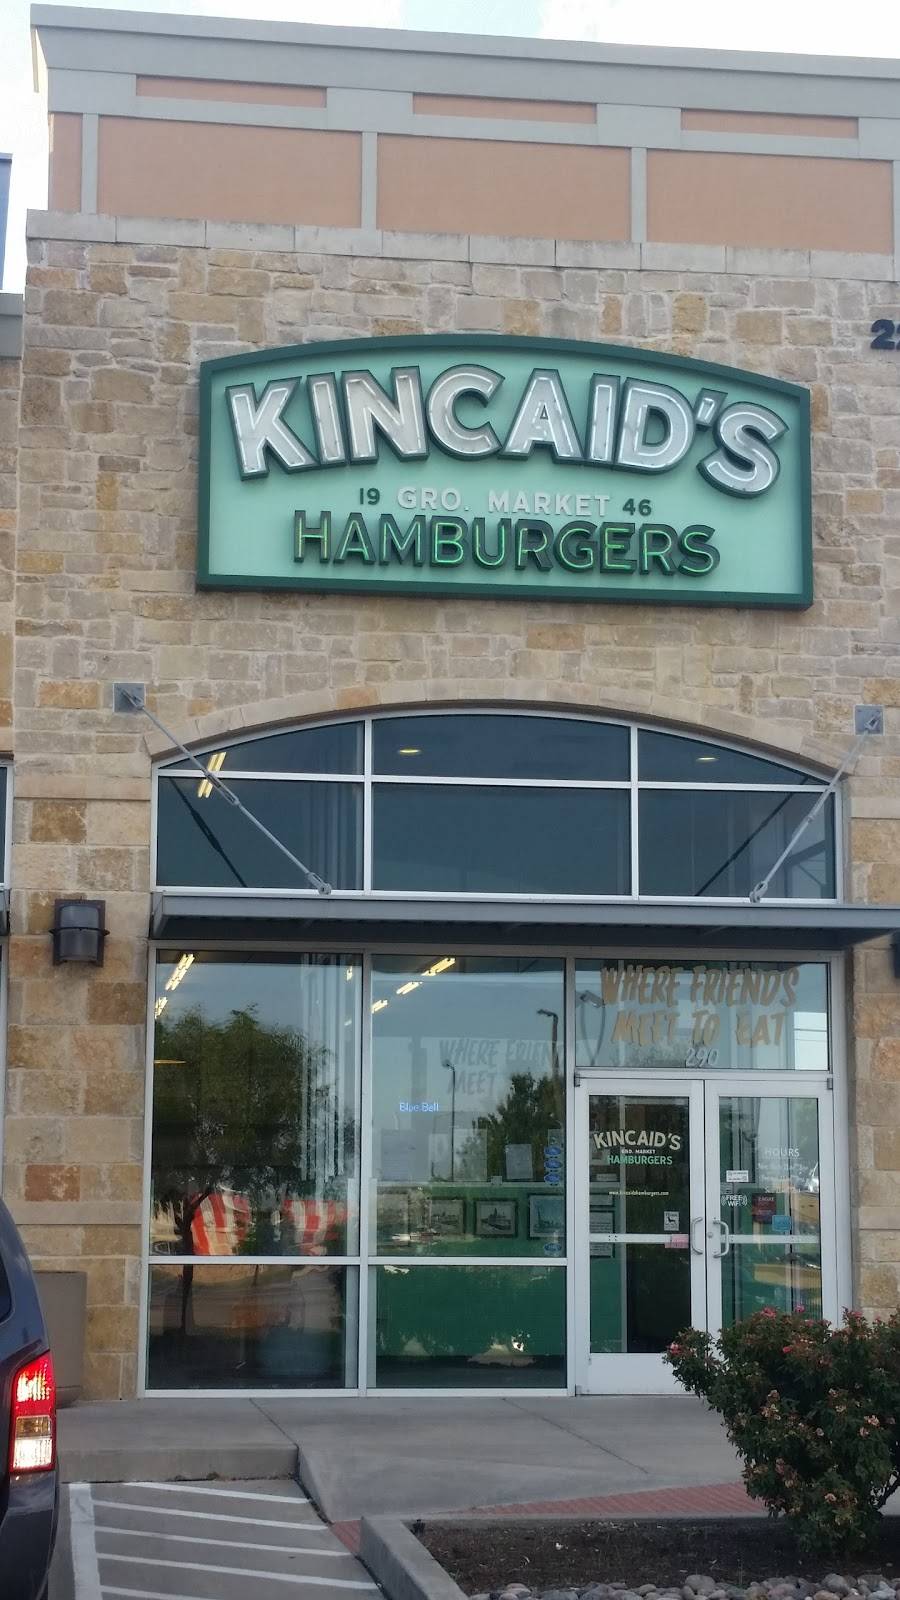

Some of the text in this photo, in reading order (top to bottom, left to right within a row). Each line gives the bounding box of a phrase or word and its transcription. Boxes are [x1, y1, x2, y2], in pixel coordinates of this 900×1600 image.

[870, 318, 900, 350] 2
[225, 364, 789, 498] KINCAID'S
[359, 487, 652, 516] 19 GRO. MARKET 46
[293, 510, 720, 577] HAMBURGERS
[601, 964, 799, 1008] WHERE FRIENDS
[611, 1010, 786, 1048] MEET TO EAT
[686, 1048, 718, 1068] 290
[400, 1102, 439, 1112] Blue Bell
[593, 1130, 681, 1151] KINCAID'S
[765, 1148, 800, 1157] HOURS
[608, 1155, 673, 1165] HAMBURGERS
